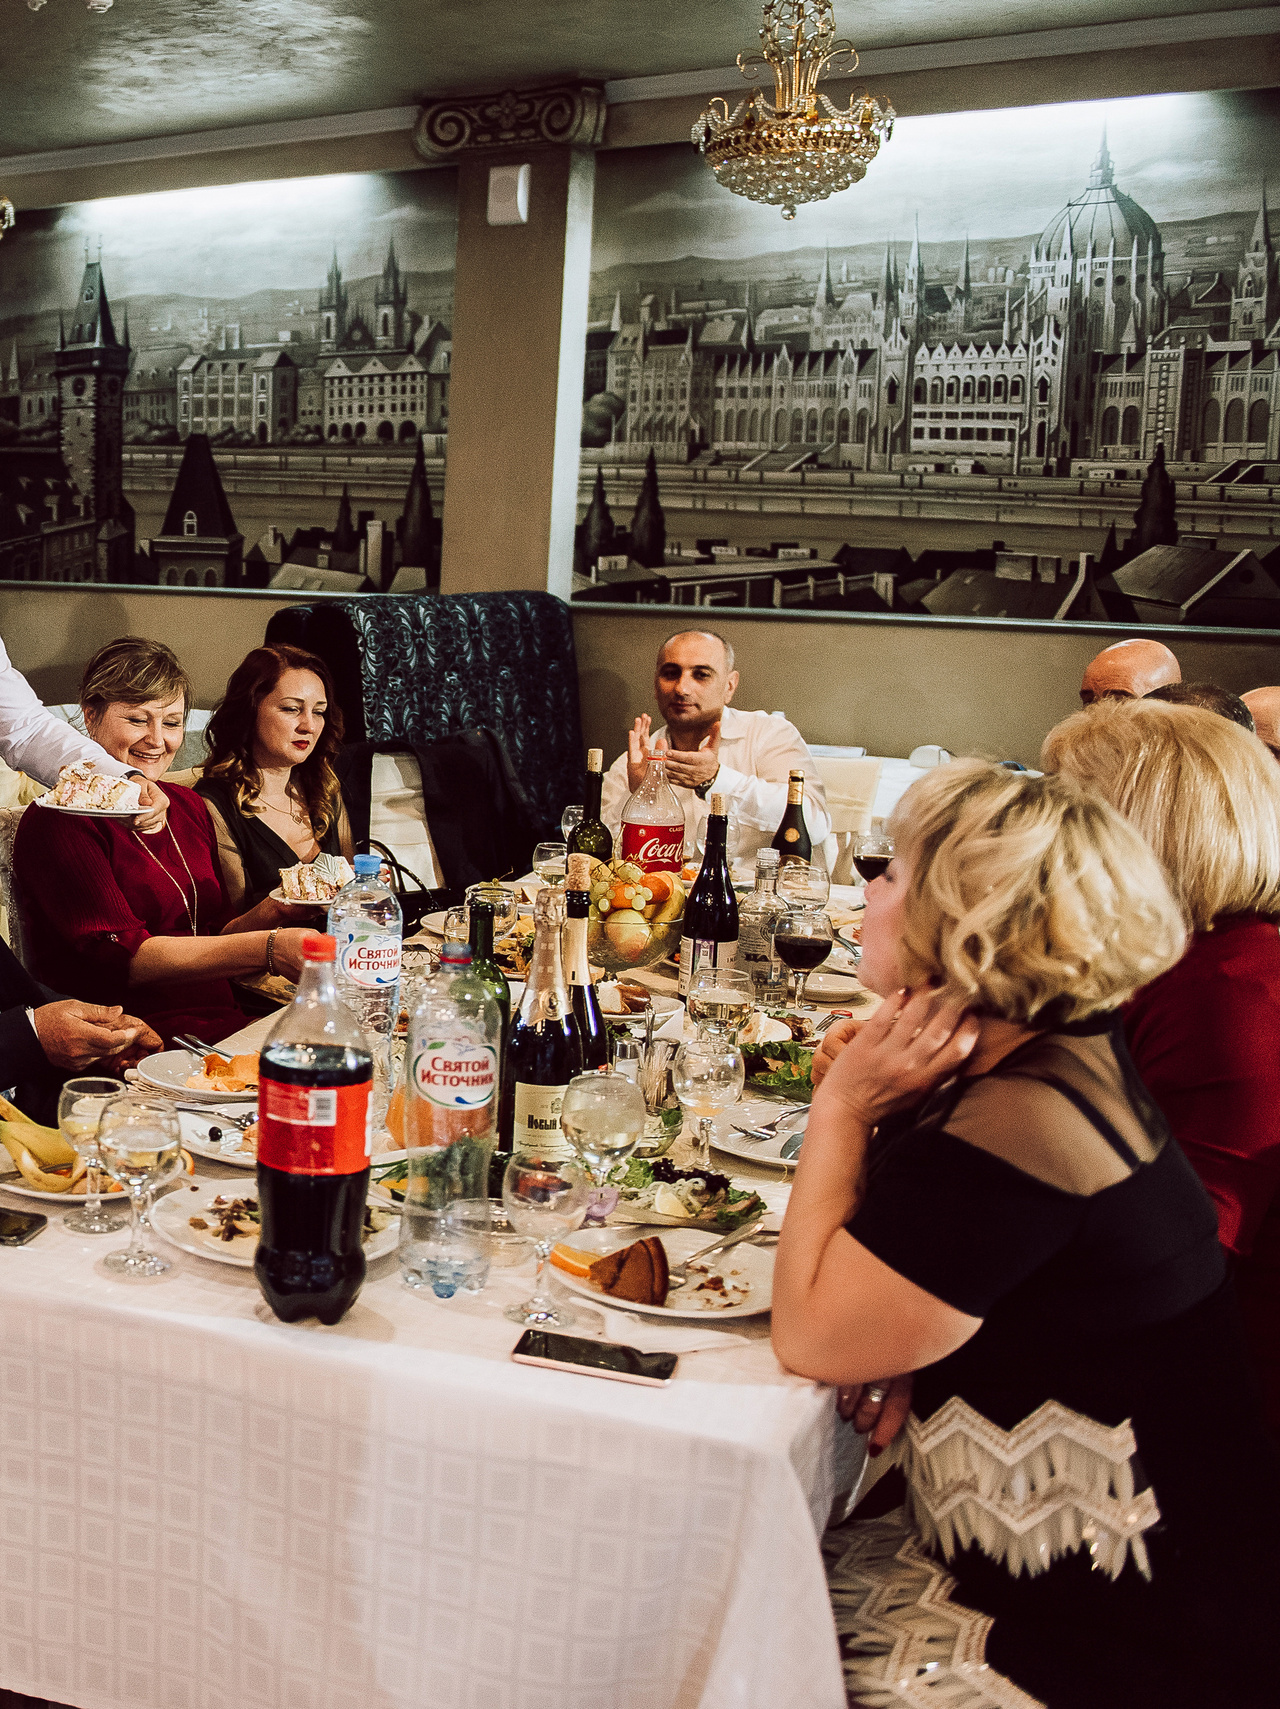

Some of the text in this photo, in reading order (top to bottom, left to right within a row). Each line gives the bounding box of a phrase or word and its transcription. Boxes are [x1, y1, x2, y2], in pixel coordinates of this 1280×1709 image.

[357, 945, 398, 959] Святой
[431, 1056, 490, 1072] Святой
[527, 1114, 557, 1130] Новый
